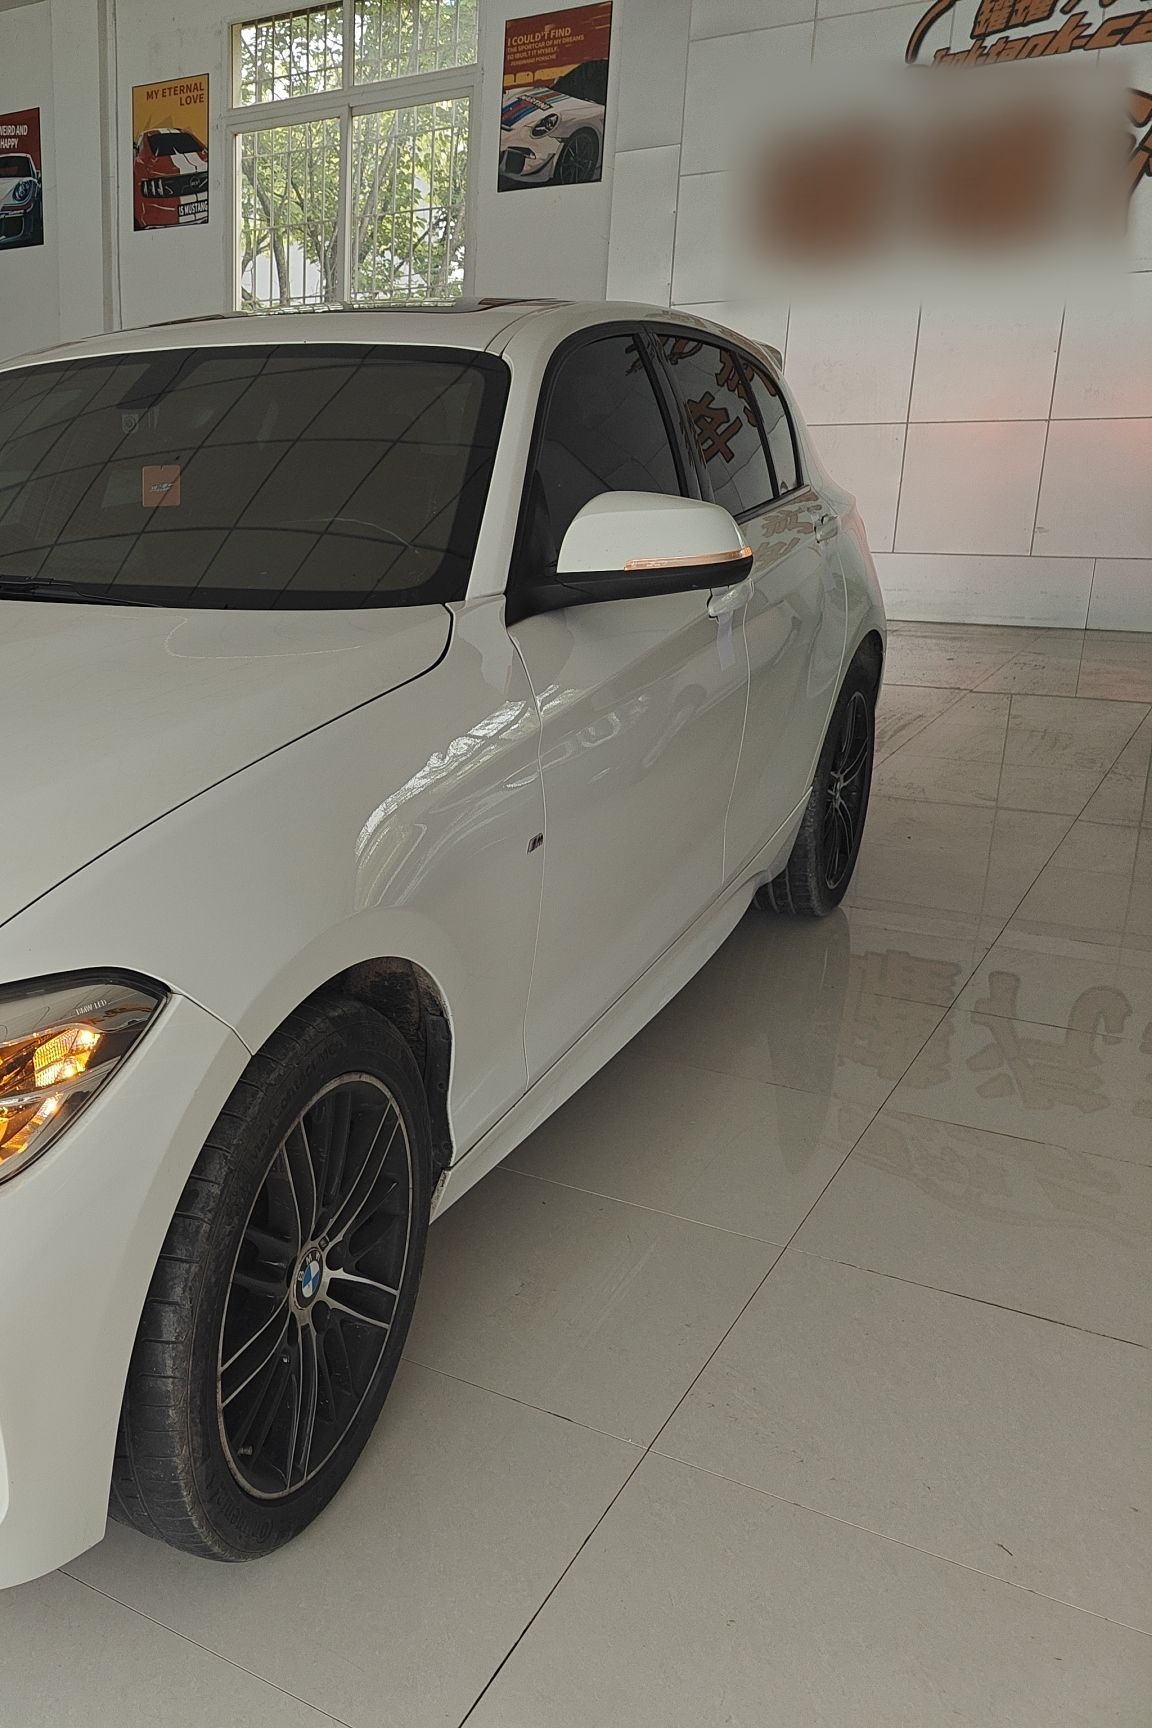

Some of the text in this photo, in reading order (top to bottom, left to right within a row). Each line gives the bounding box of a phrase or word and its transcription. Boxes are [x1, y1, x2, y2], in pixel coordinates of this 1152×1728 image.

[512, 31, 550, 46] COULD'T
[550, 27, 572, 39] FIND
[562, 34, 585, 44] DREAMS
[146, 81, 205, 101] MY ETERNAL
[179, 93, 205, 107] LOVE
[16, 124, 28, 136] AND
[0, 137, 19, 149] HAPPY
[178, 200, 208, 216] IS MUSTANG
[75, 1002, 94, 1017] BMW
